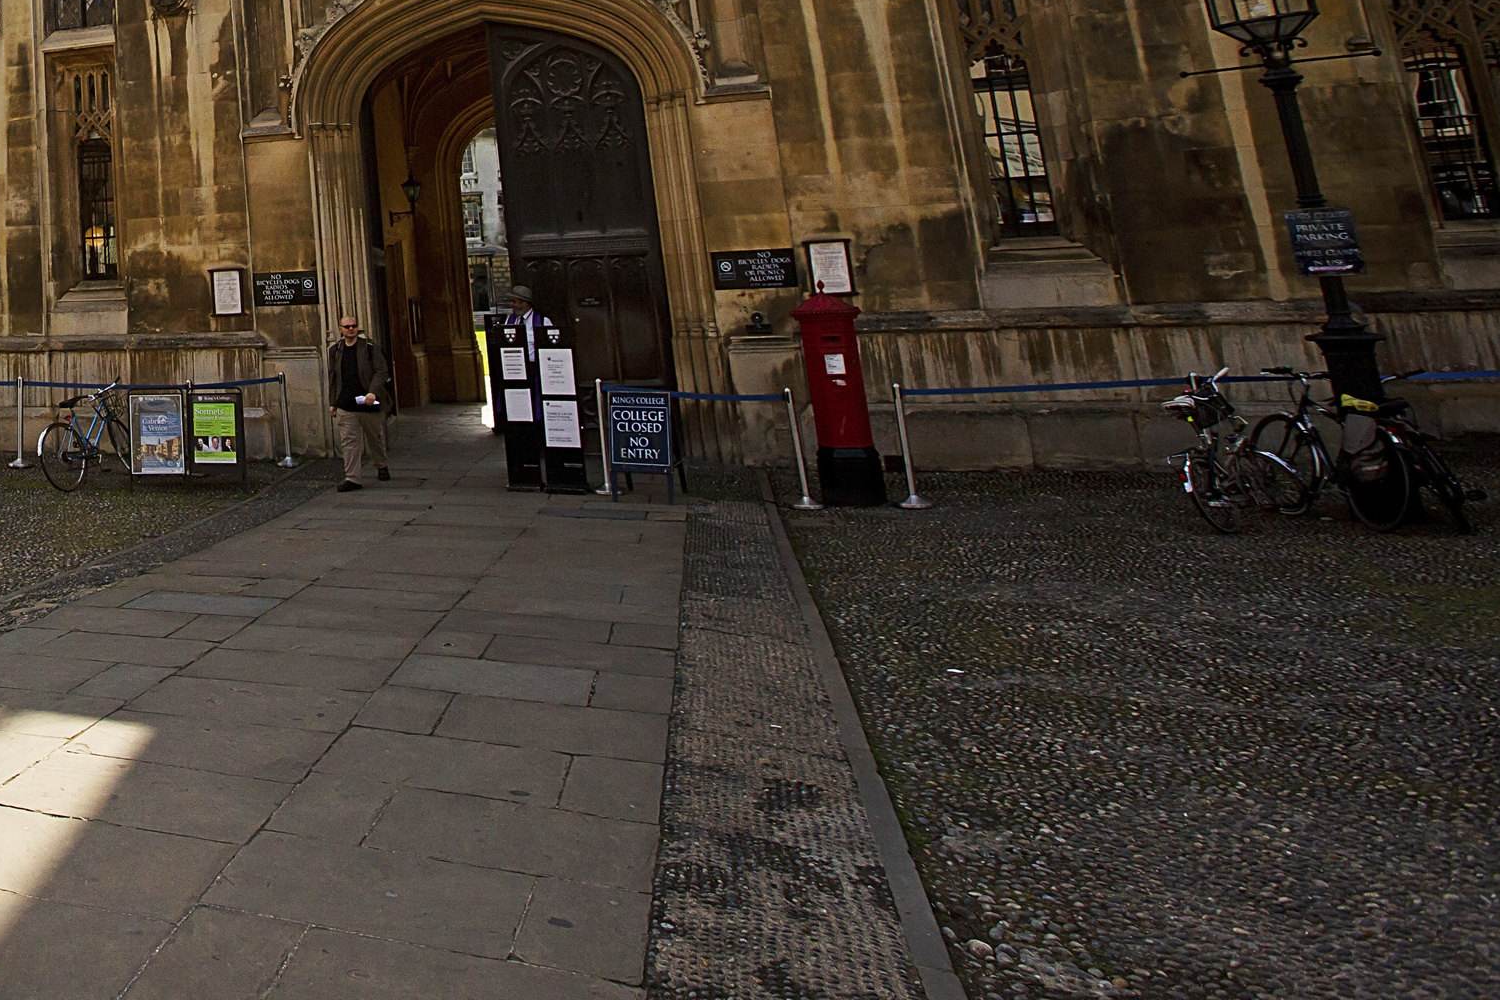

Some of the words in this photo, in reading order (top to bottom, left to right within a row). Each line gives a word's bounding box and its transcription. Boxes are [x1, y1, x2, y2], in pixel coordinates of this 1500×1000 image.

[1295, 223, 1347, 232] PRIVATE
[1295, 232, 1348, 241] PARKING
[612, 396, 635, 404] KING'S
[636, 397, 665, 405] COLLEGE
[612, 410, 665, 421] COLLEGE
[616, 422, 662, 433] CLOSED
[629, 437, 649, 447] NO
[621, 448, 660, 459] ENTRY
